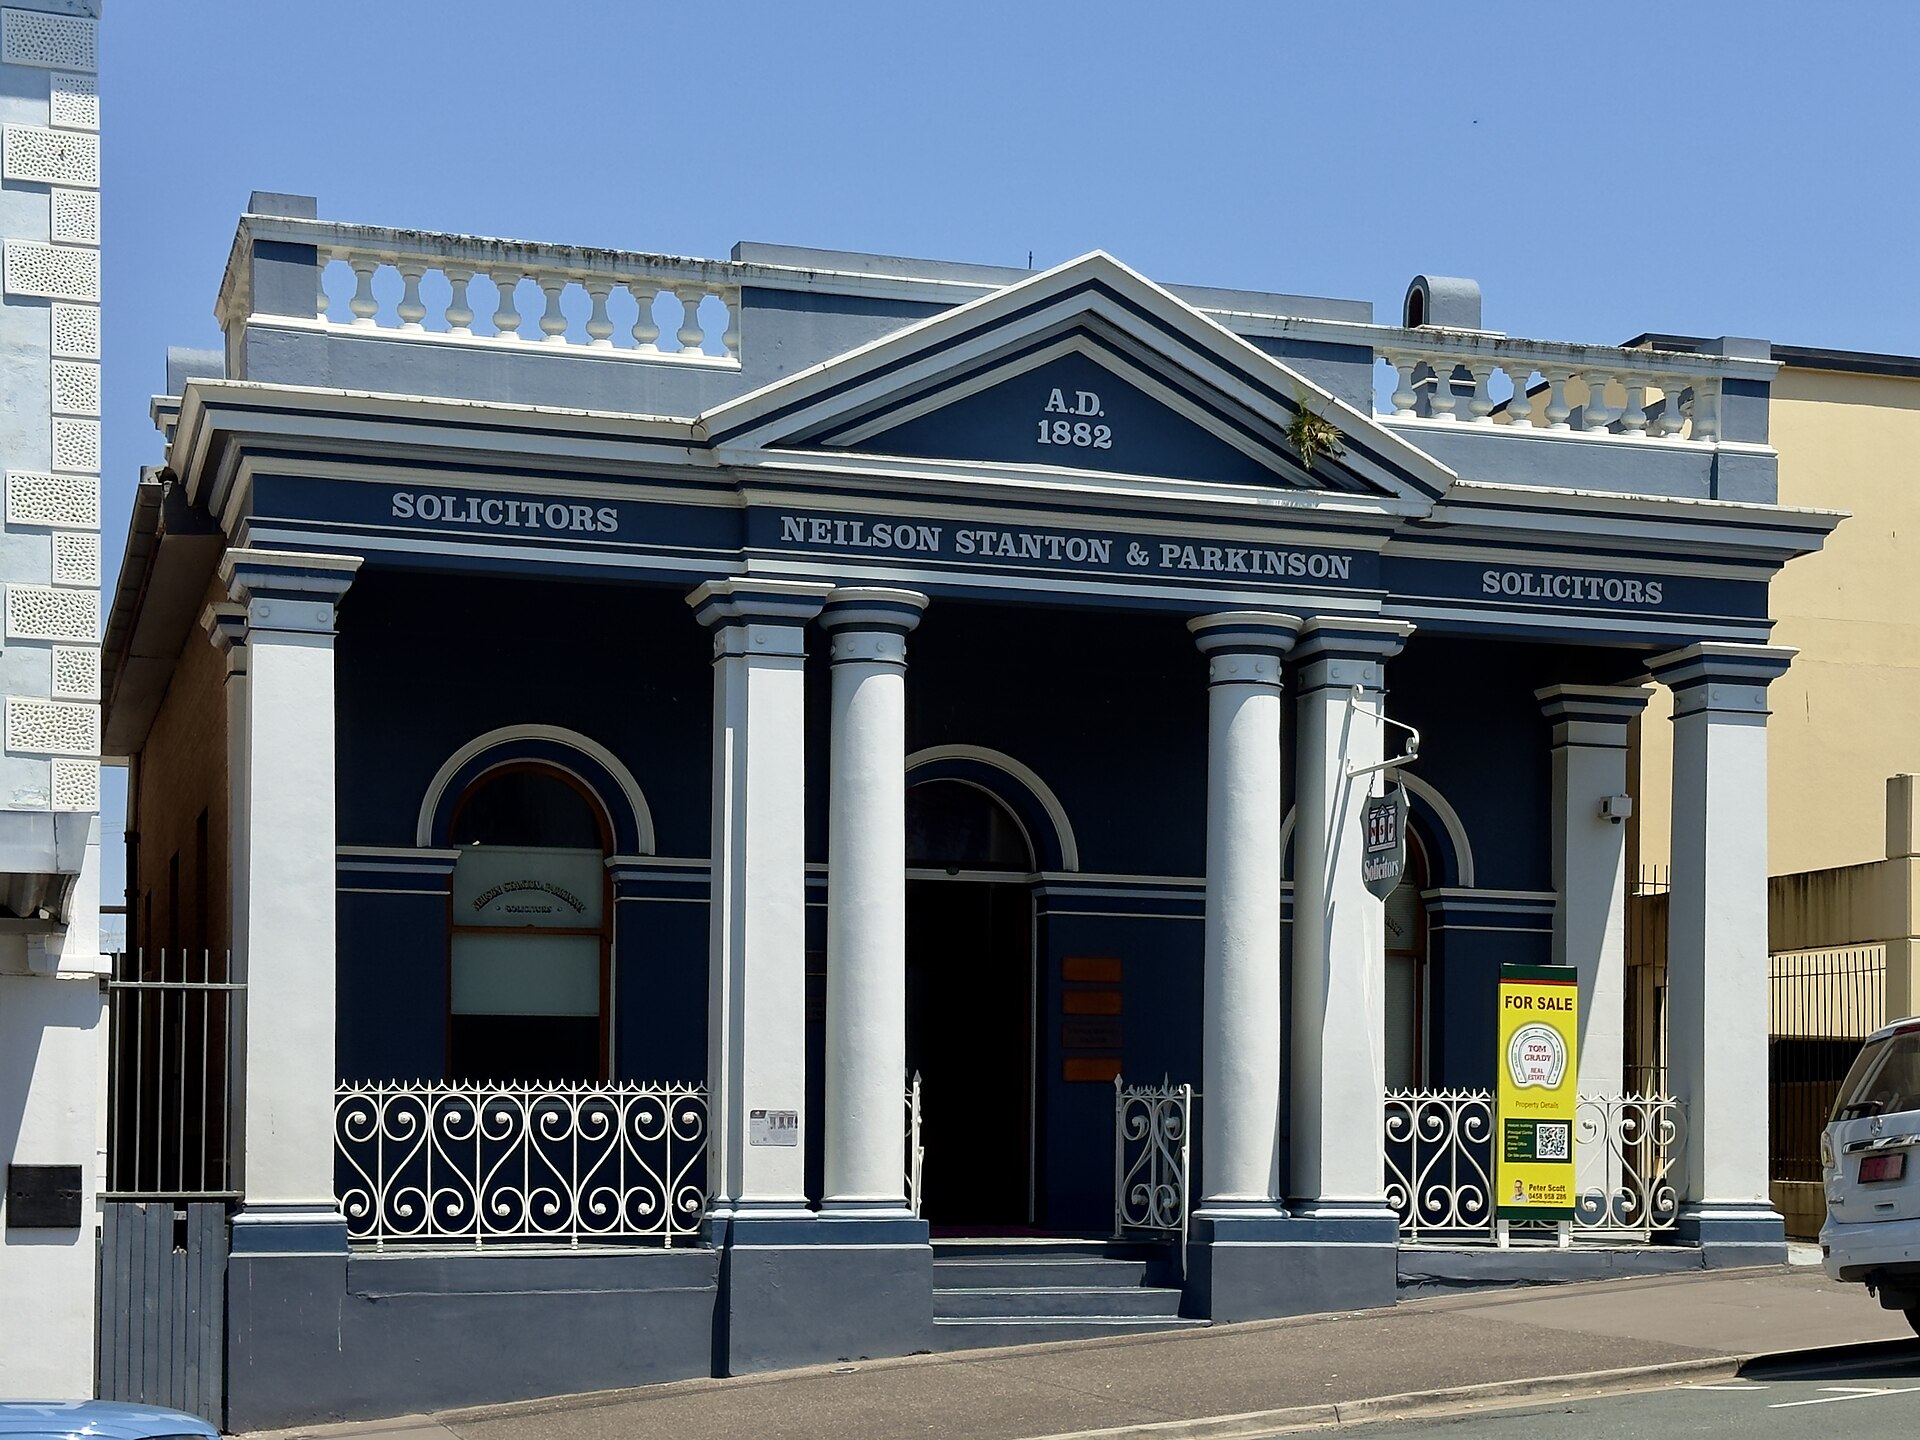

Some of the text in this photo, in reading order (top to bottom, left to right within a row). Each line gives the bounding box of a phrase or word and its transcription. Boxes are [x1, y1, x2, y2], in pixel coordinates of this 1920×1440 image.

[1044, 388, 1105, 418] A.D.
[1037, 419, 1113, 449] 1882
[392, 492, 619, 534] SOLICITORS
[780, 516, 1353, 580] NEILSON STANTON & PARKINSON
[1482, 570, 1664, 605] SOLICITORS
[1364, 857, 1399, 882] Solicitors
[1505, 996, 1573, 1011] FOR SALE
[1524, 1054, 1552, 1062] GRADY
[1528, 1045, 1547, 1053] TOM
[1515, 1101, 1539, 1110] Property
[1528, 1183, 1566, 1193] Peter Scott
